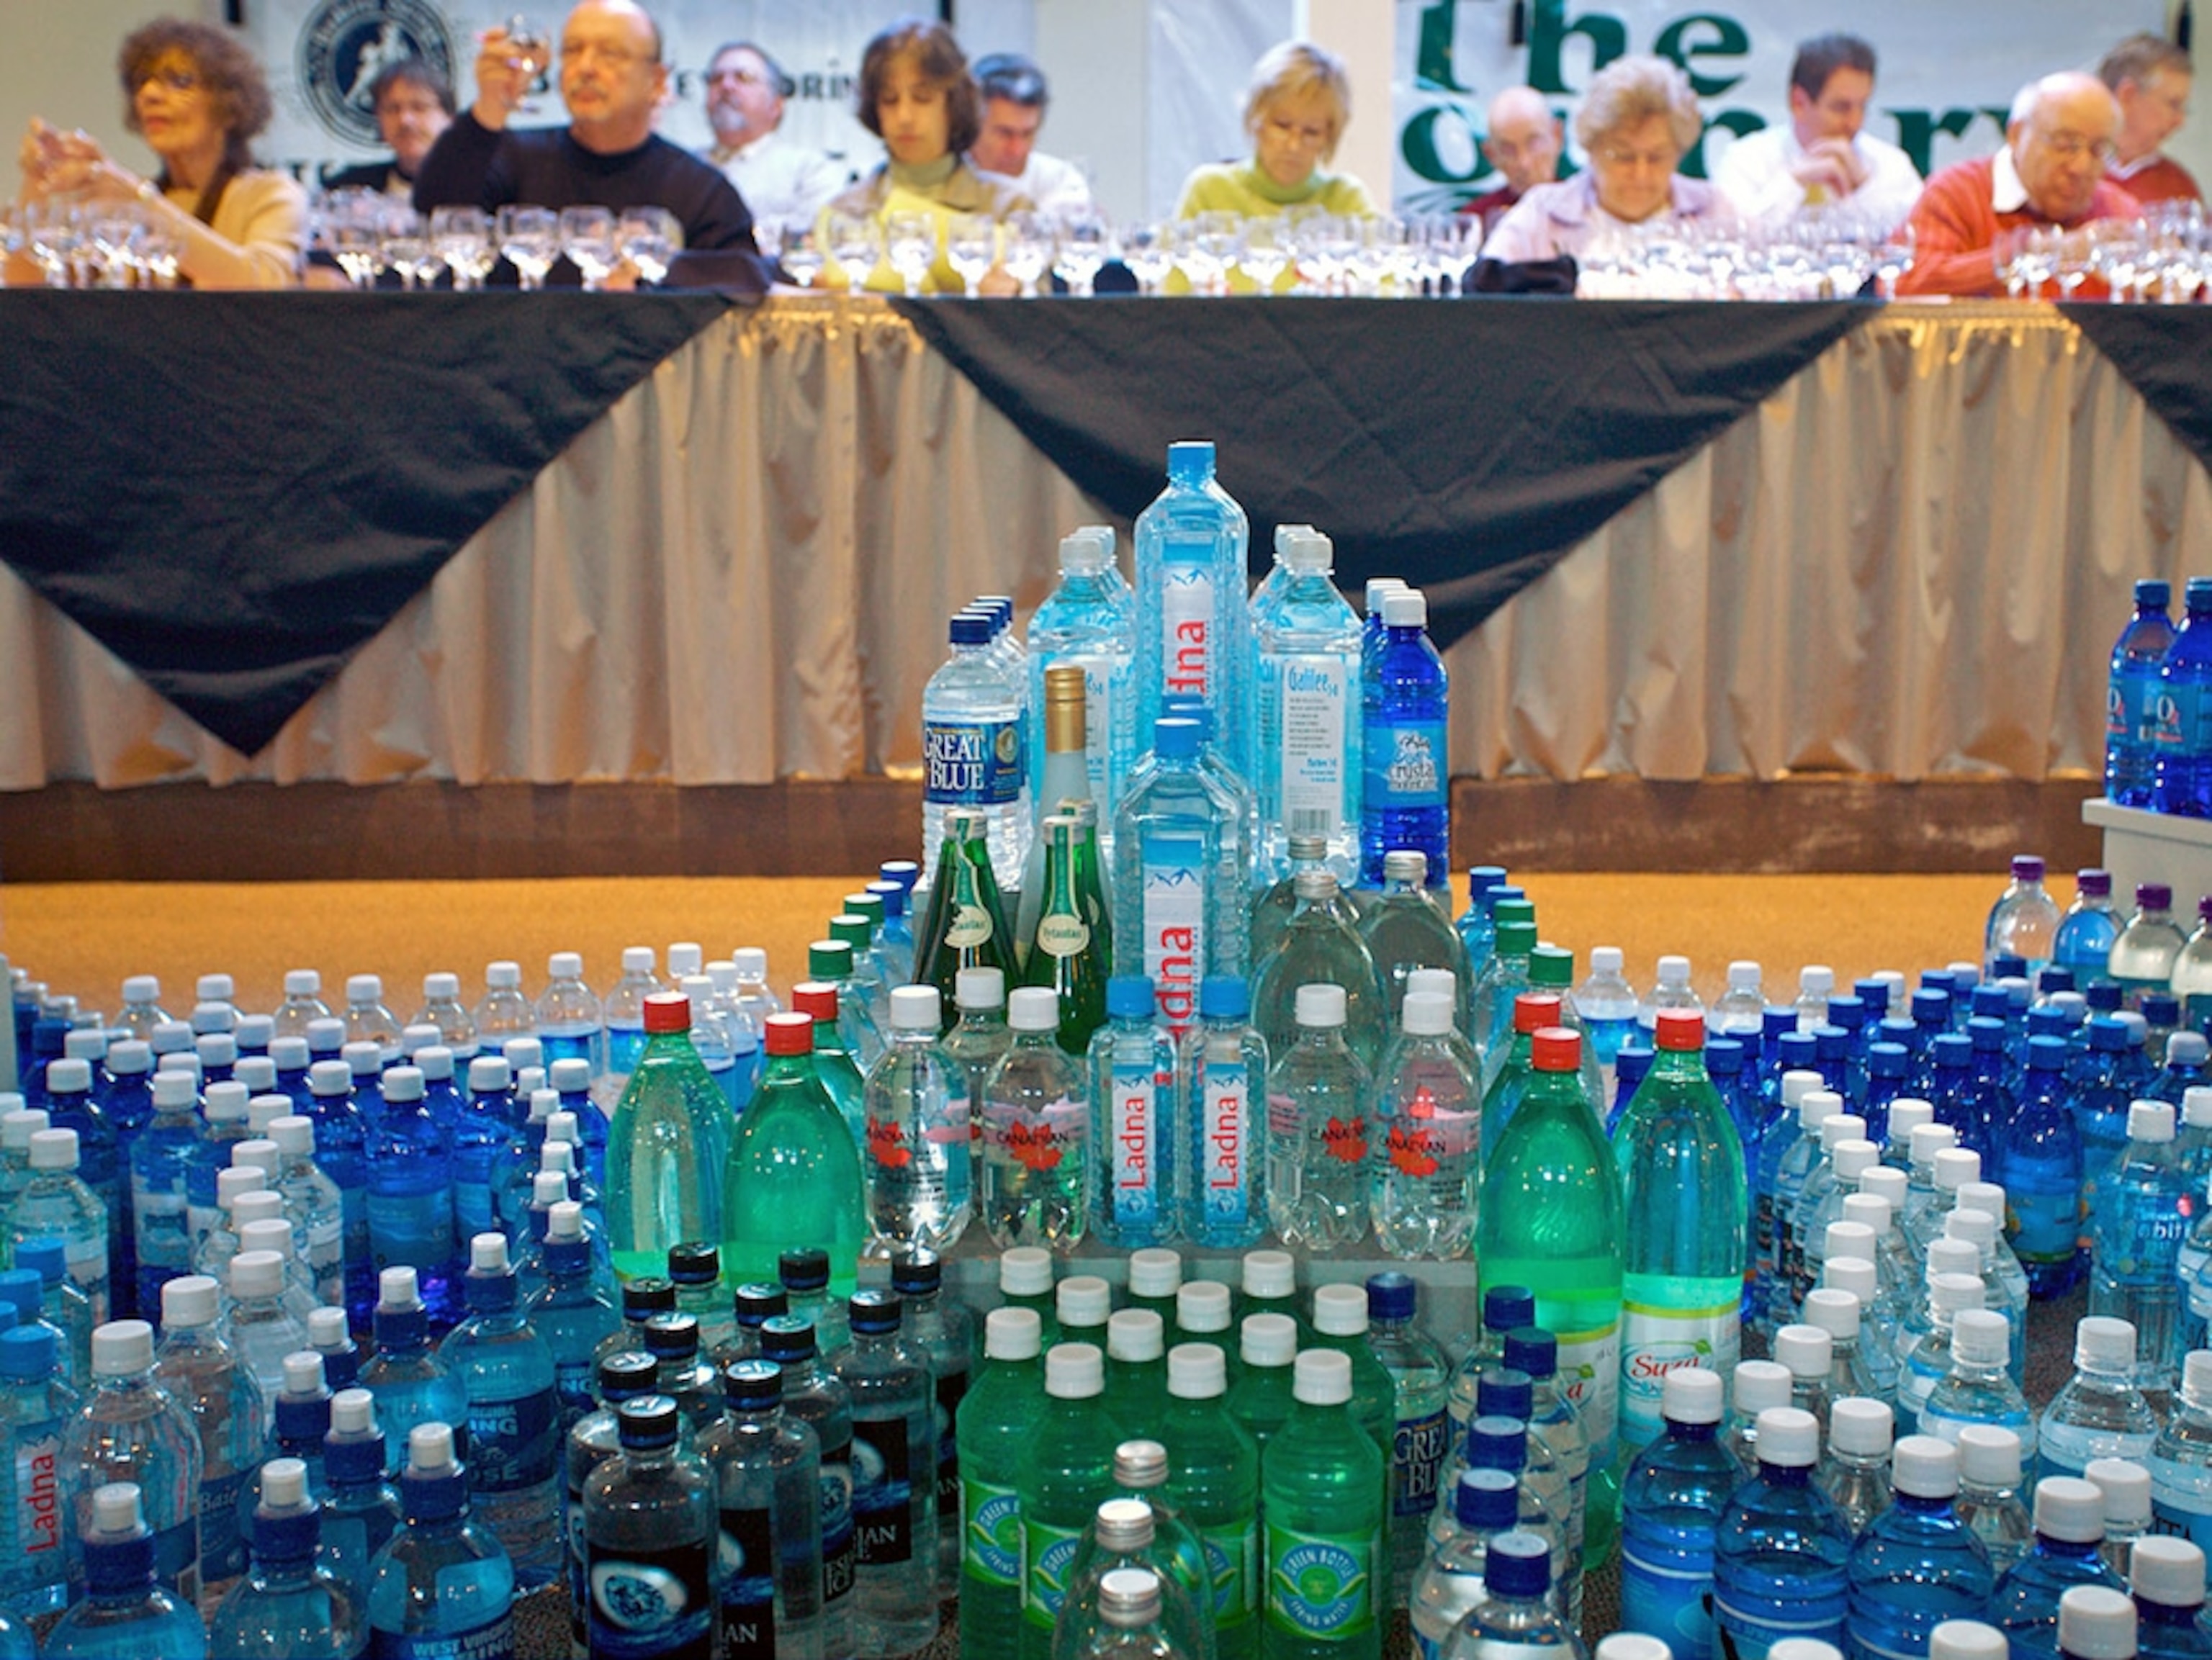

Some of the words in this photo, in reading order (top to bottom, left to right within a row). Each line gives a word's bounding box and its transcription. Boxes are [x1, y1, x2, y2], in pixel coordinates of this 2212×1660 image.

[925, 727, 986, 761] GREAT
[930, 759, 985, 792] BLUE
[1120, 1097, 1146, 1189] Ladna
[1211, 1096, 1238, 1189] Ladna
[469, 1417, 518, 1435] ING
[26, 1453, 57, 1553] Ladna
